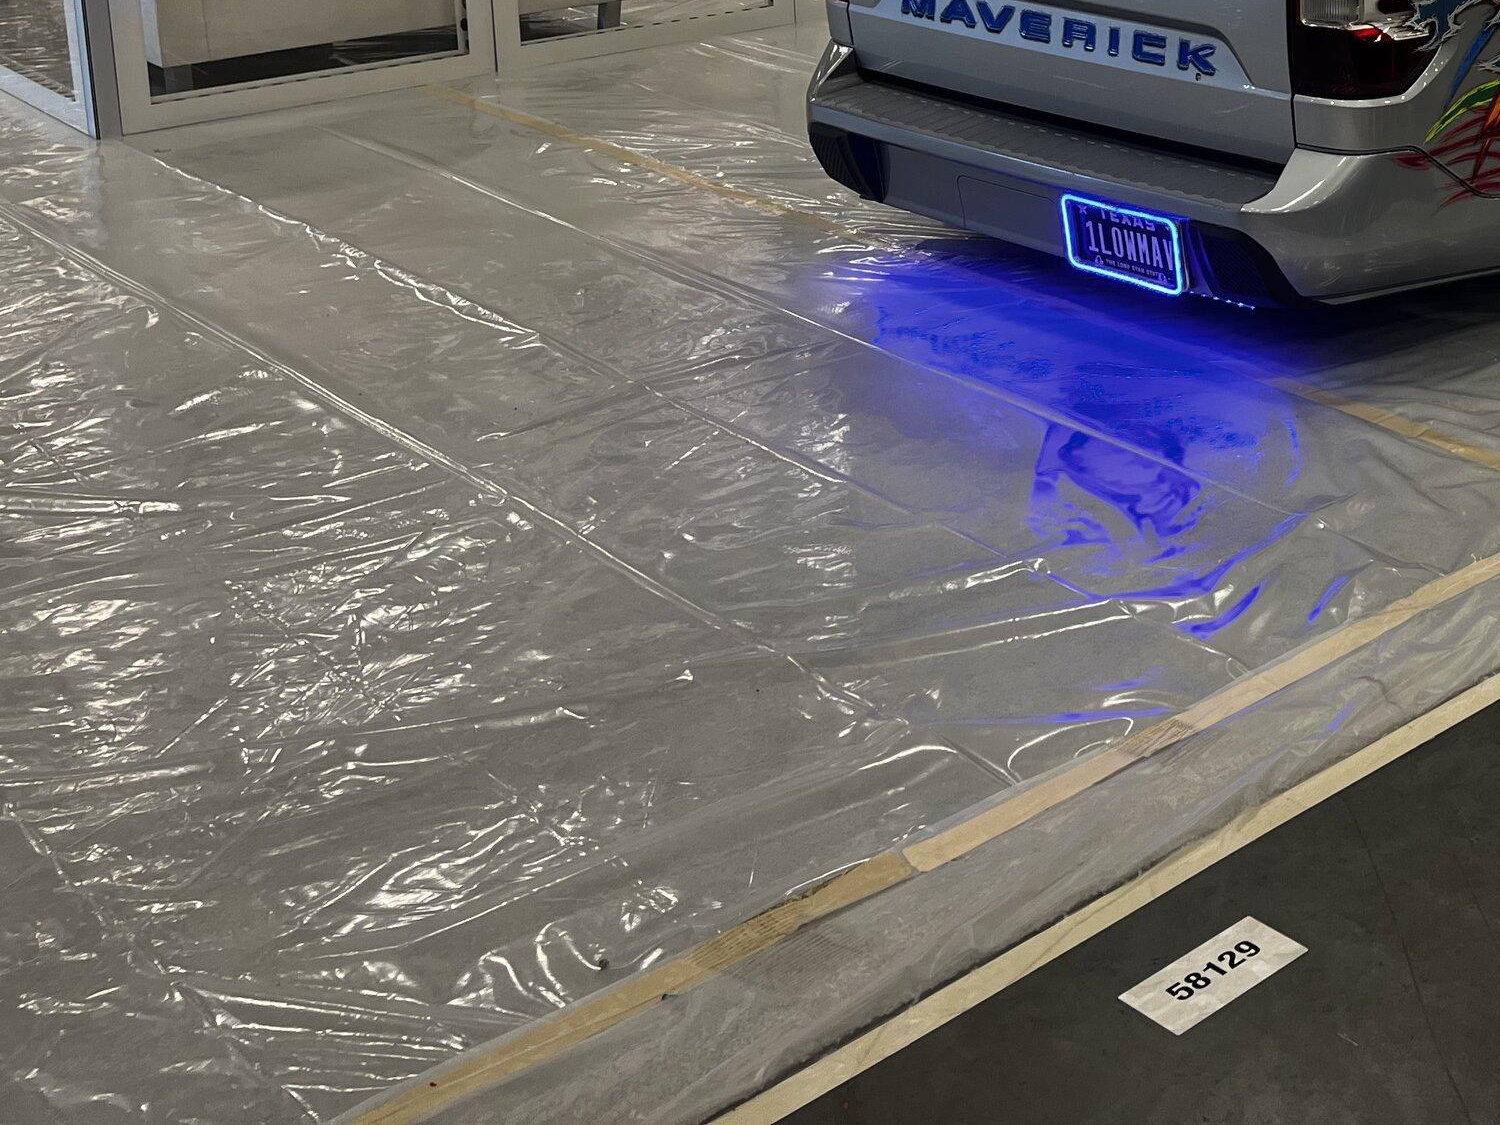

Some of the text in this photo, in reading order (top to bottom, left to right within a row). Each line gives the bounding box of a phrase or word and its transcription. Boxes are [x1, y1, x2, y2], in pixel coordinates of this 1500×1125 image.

[1100, 209, 1155, 232] TEXAS
[1086, 221, 1174, 271] 1LOWMAV
[1165, 940, 1261, 1001] 58129
